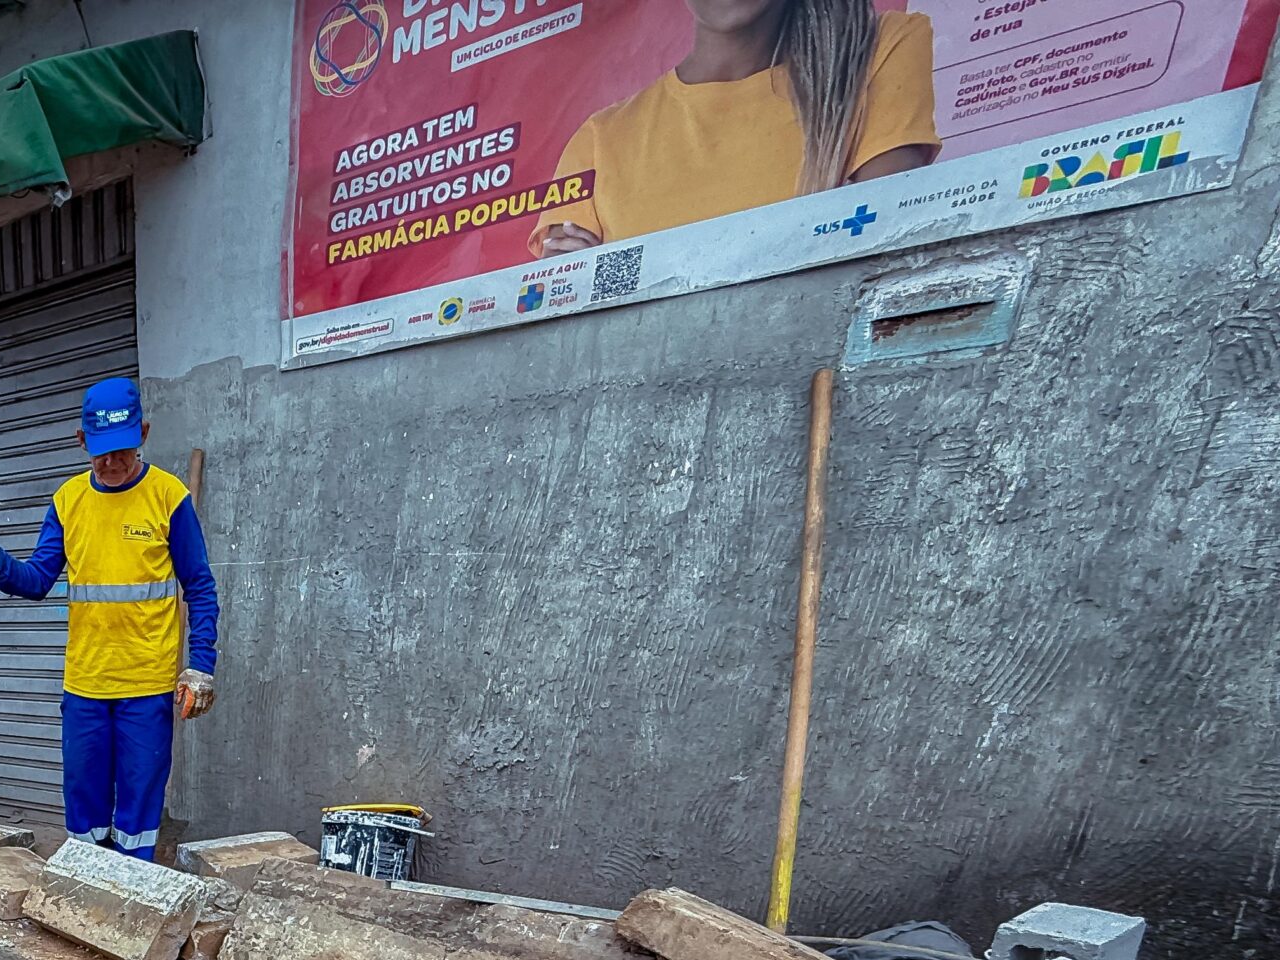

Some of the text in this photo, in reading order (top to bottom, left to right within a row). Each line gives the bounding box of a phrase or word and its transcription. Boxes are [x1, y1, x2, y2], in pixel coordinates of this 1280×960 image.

[456, 12, 577, 65] UM CICLO DE RESPEITO
[970, 19, 1023, 43] de rua
[956, 52, 1094, 97] com foto, cadastro no
[959, 30, 1128, 85] Basta ter CPF, documento
[951, 57, 1156, 121] autorização no Meu SUS Digital.
[954, 85, 1017, 109] CadÚnico
[1028, 66, 1080, 88] Gov.BR
[1090, 52, 1133, 72] emitir
[335, 105, 475, 173] AGORA TEM
[1040, 115, 1186, 158] GOVERNO FEDERAL
[332, 127, 515, 204] ABSORVENTES
[1019, 131, 1191, 199] BRASIL
[330, 163, 511, 233] GRATUITOS NO
[898, 178, 999, 209] MINISTÉRIO DA
[950, 190, 997, 209] SAÚDE
[1027, 196, 1062, 210] UNIÃO
[327, 176, 590, 264] FARMÁCIA POPULAR.
[812, 219, 842, 237] SUS
[521, 260, 588, 283] BAIXE AQUI:
[549, 283, 573, 298] SUS
[551, 276, 567, 285] Meu
[548, 293, 578, 308] Digital
[130, 529, 152, 538] LAURO
